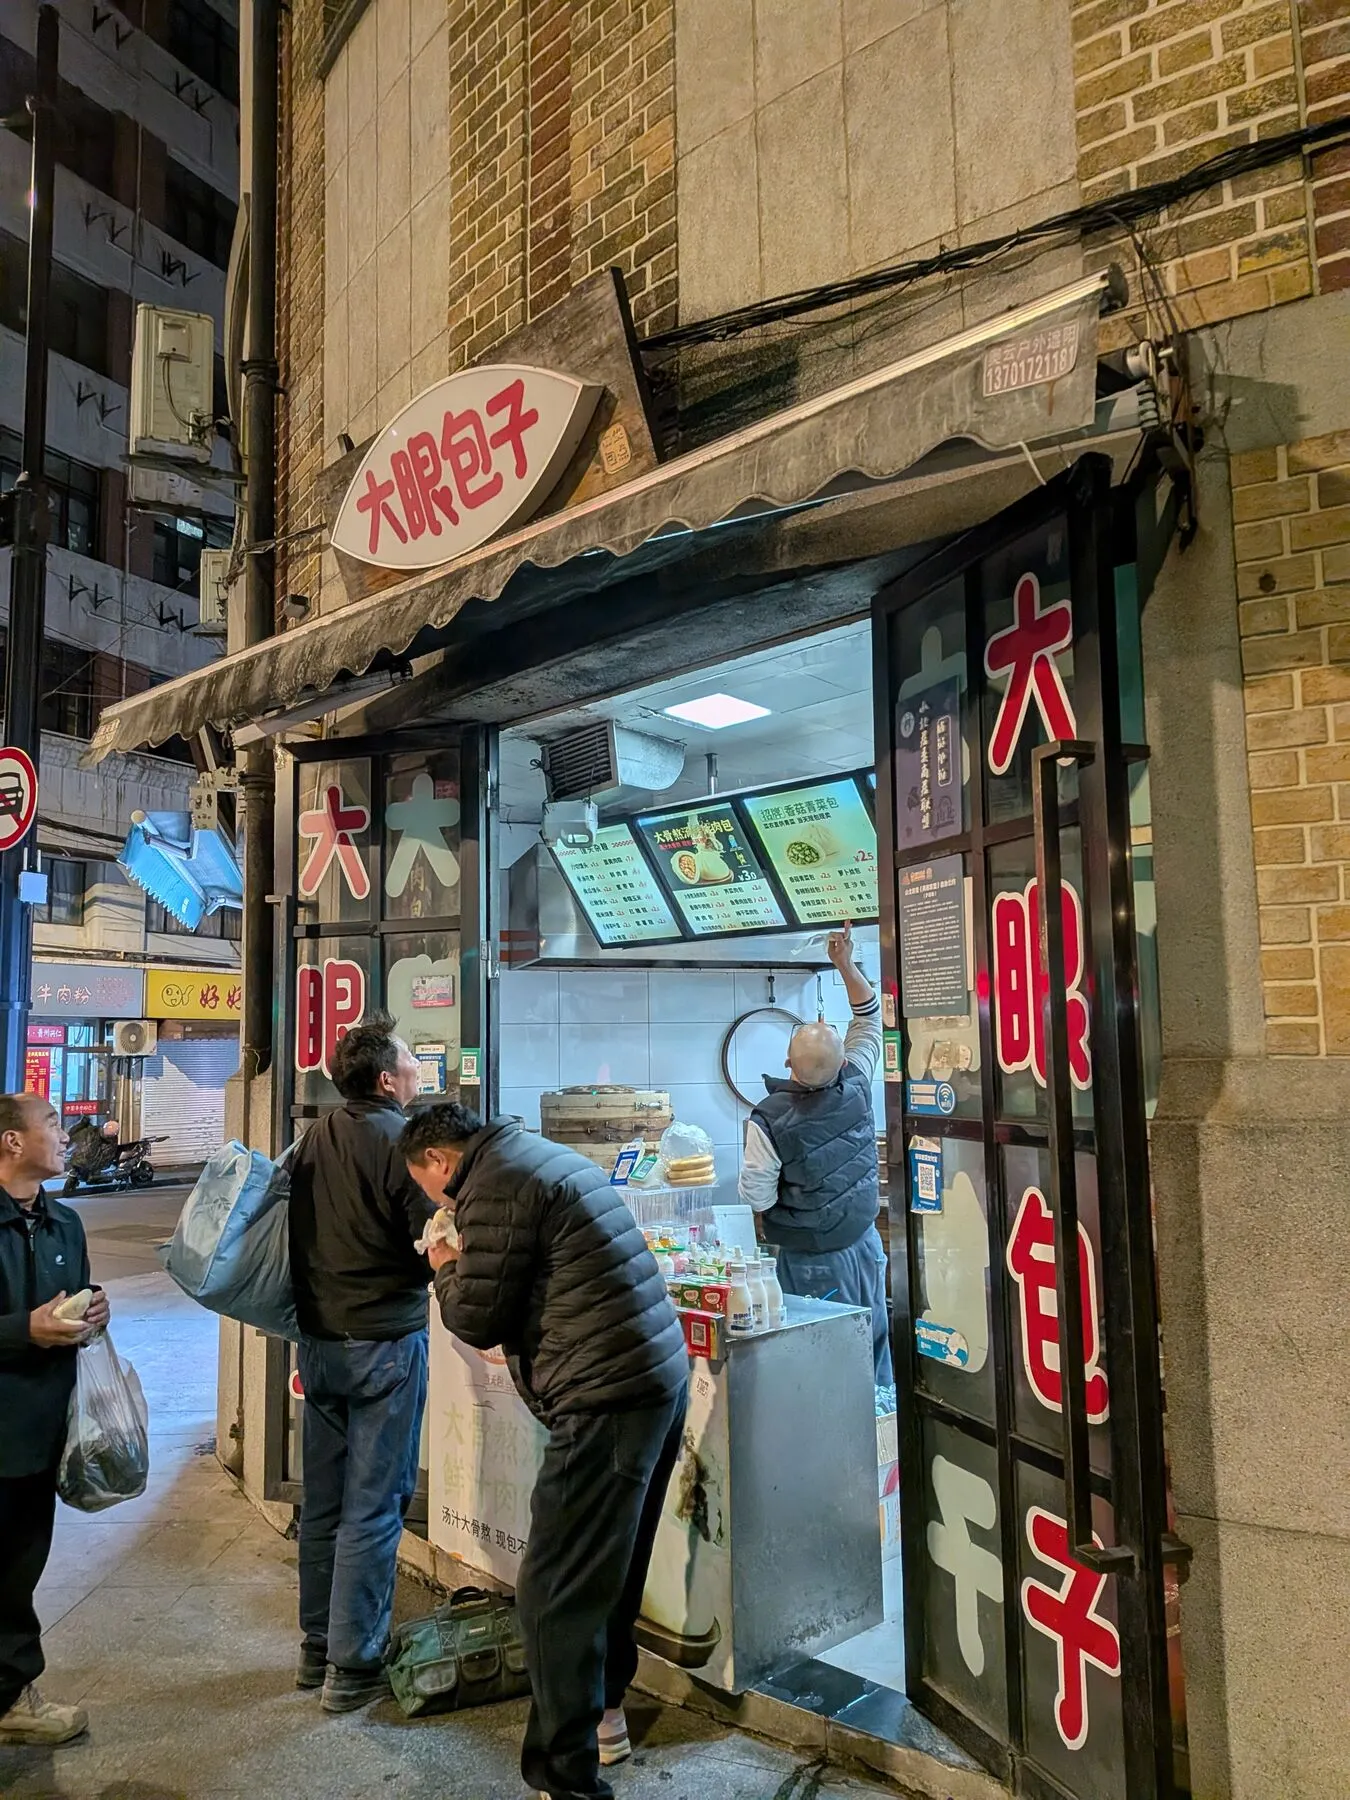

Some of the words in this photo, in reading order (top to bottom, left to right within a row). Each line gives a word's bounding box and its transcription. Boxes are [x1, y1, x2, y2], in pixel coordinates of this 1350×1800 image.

[987, 345, 1076, 392] 13701721181
[356, 379, 538, 553] 大眼包子
[784, 797, 839, 817] 香菇青菜包
[37, 983, 92, 1005] 牛肉粉
[441, 1506, 492, 1546] 汤汁大骨熬
